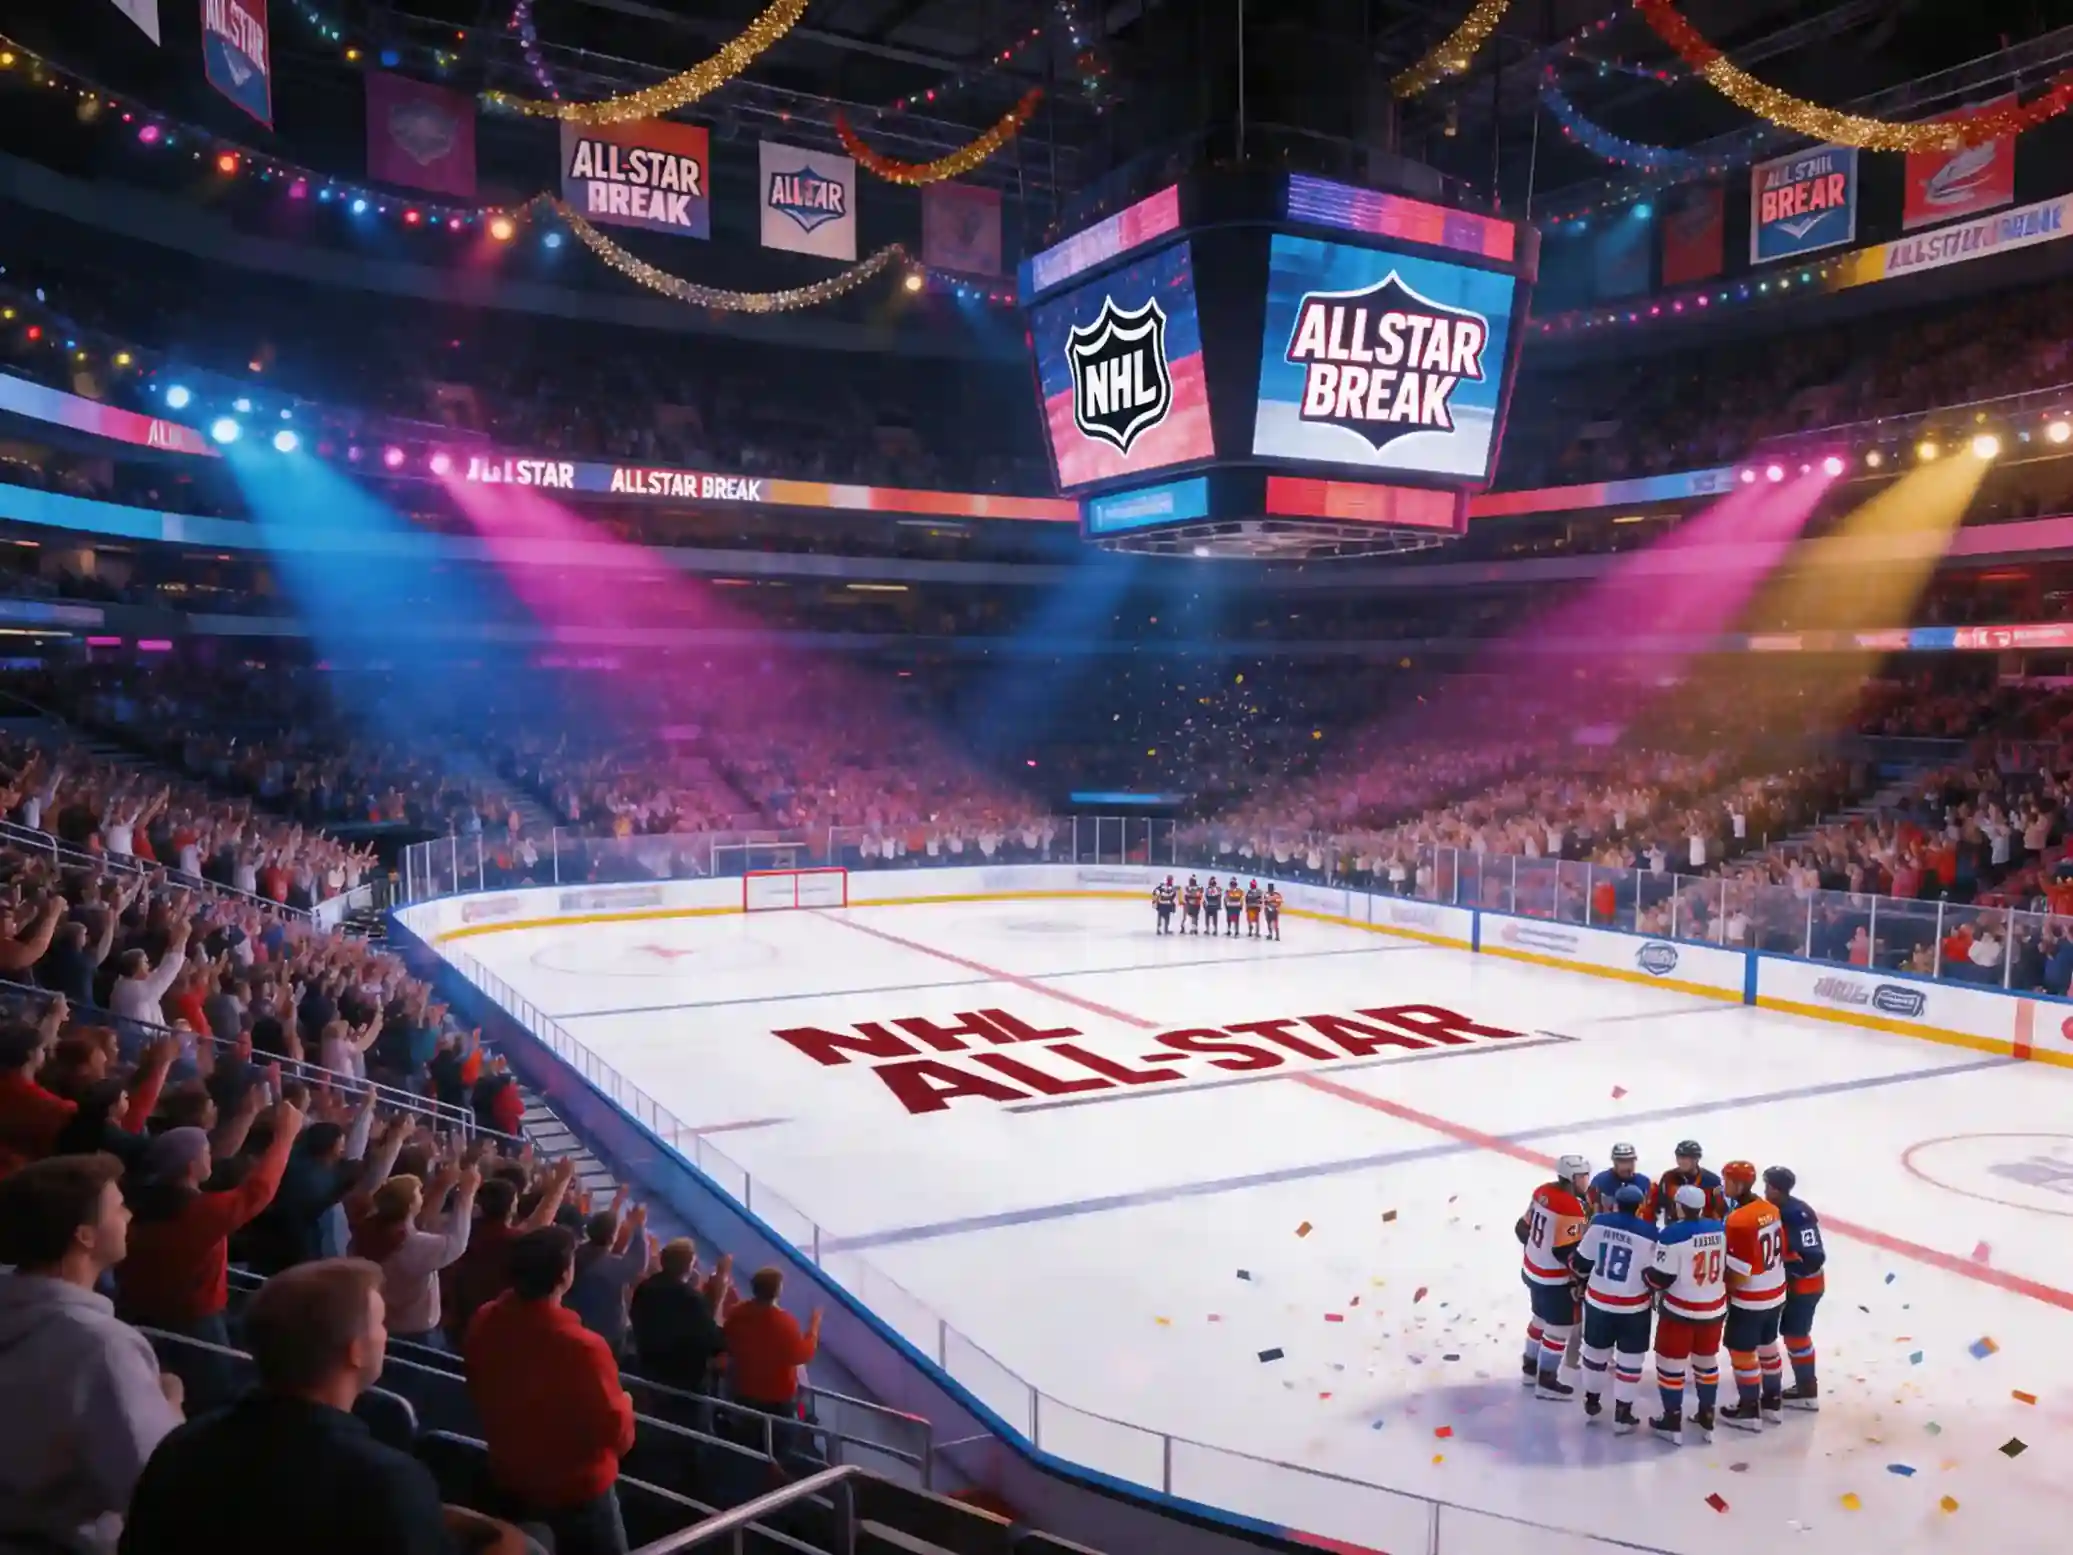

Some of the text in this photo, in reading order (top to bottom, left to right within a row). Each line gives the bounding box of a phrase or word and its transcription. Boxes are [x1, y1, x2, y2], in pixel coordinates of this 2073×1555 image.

[1085, 349, 1157, 417] NHL
[1303, 362, 1456, 428] BREAK
[701, 476, 761, 501] BREAK
[770, 1008, 1083, 1066] NHL
[870, 1003, 1530, 1114] ALL-STAR
[1595, 1241, 1633, 1283] 18
